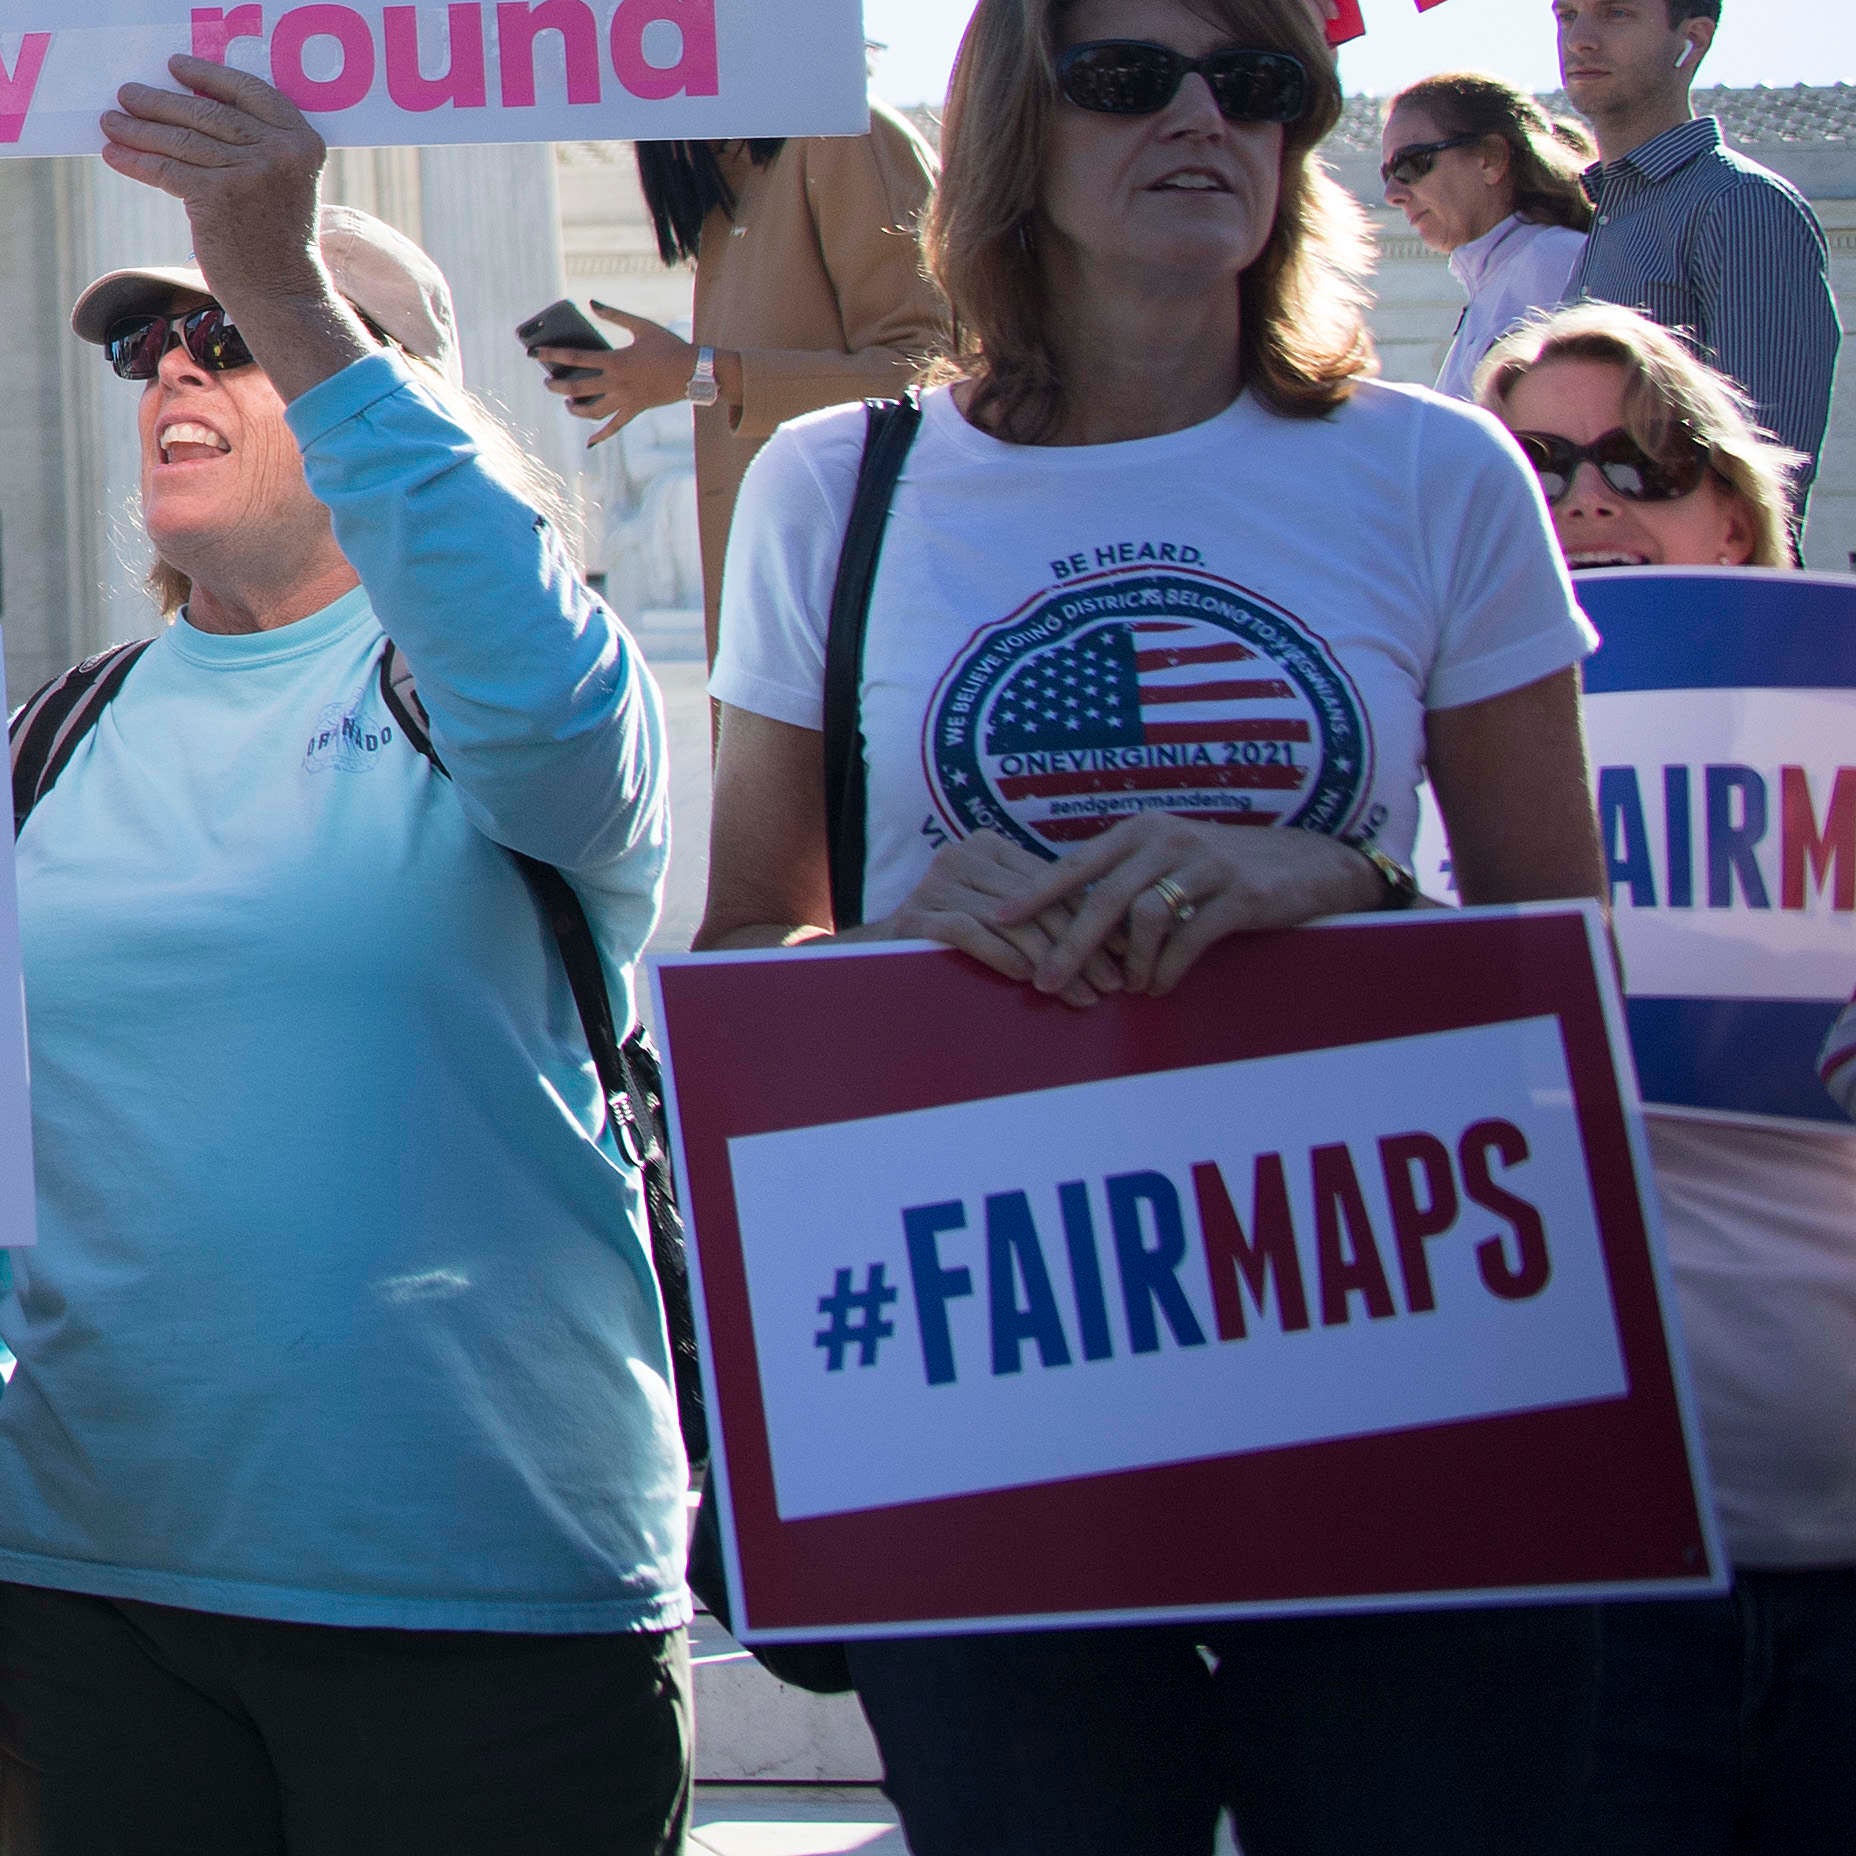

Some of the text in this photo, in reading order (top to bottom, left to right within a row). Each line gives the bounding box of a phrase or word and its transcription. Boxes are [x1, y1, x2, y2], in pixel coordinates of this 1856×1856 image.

[1050, 542, 1205, 580] BE HEARD.
[994, 614, 1062, 656] VOTING
[952, 654, 1003, 713] BELIEVE
[945, 716, 965, 747] WE
[999, 740, 1293, 776] ONEVIRGINIA 2021
[1596, 762, 1856, 911] AIRM
[813, 1117, 1551, 1388] #FAIRMAPS
